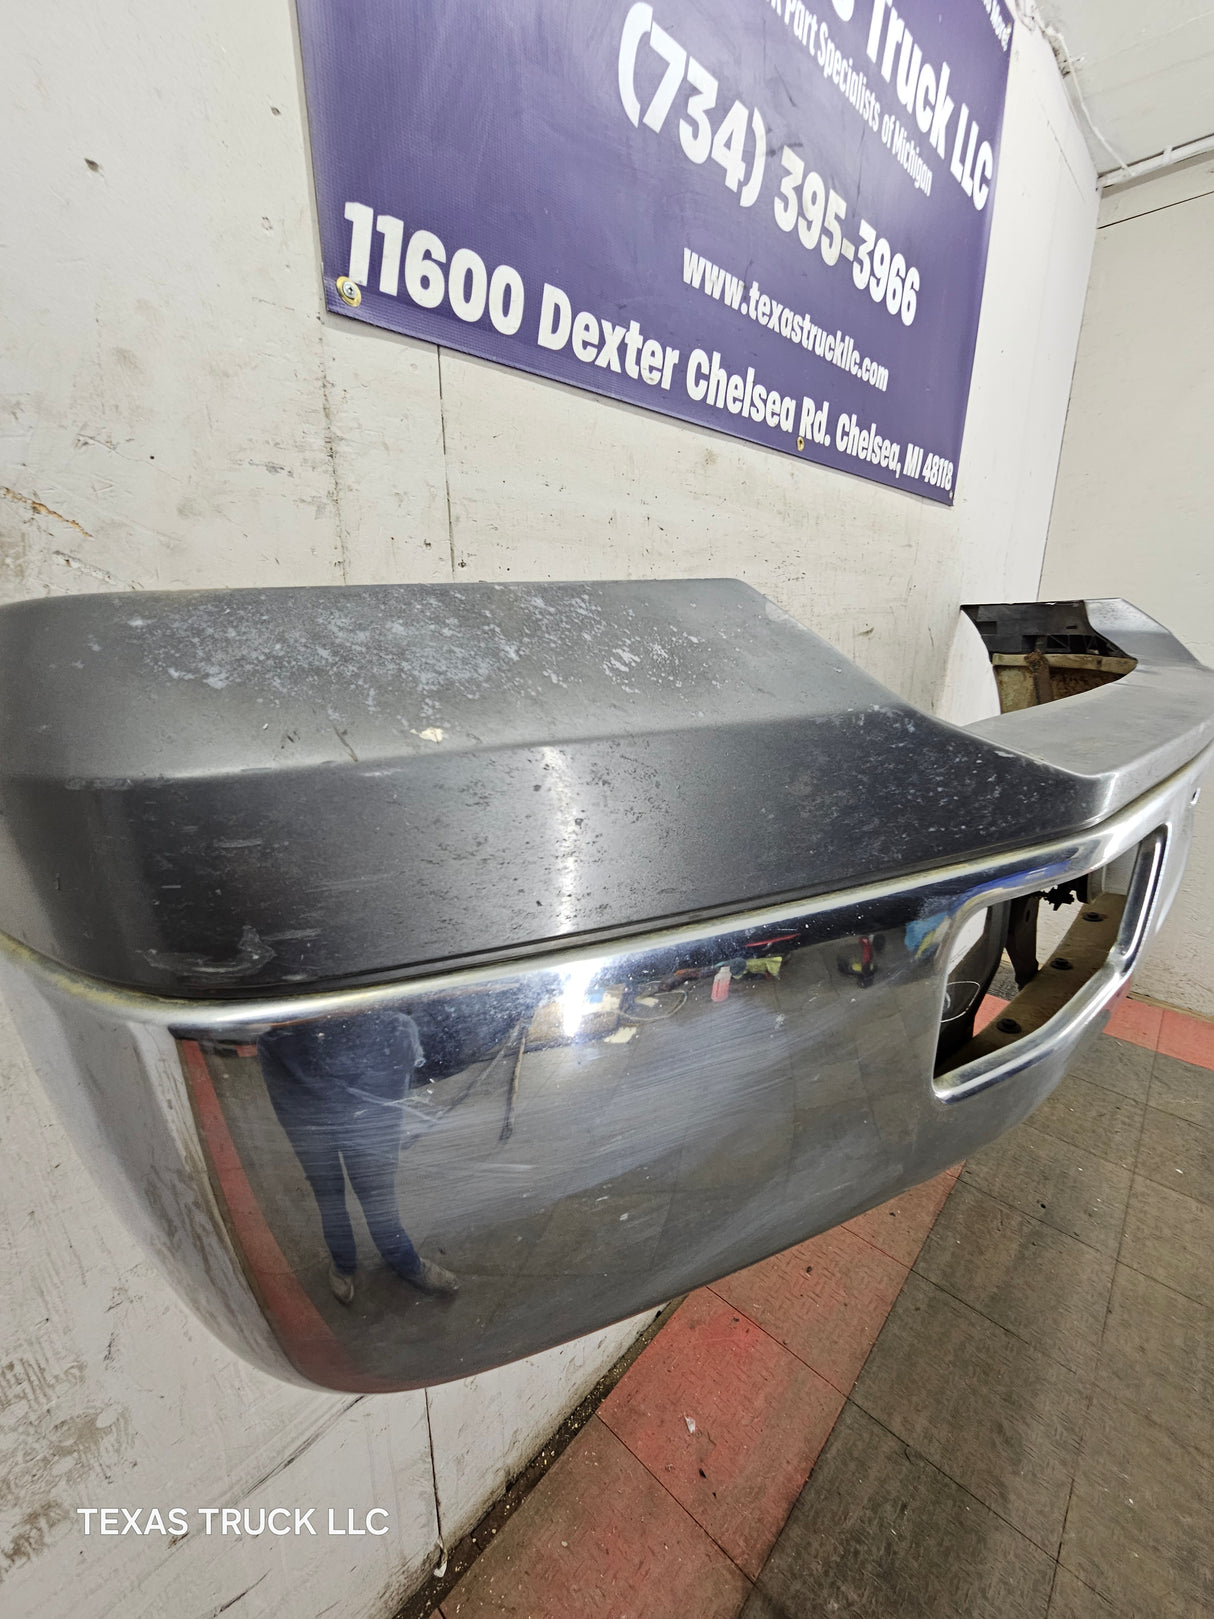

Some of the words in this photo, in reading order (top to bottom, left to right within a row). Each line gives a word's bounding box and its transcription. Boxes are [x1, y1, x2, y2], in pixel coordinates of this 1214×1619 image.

[618, 2, 767, 207] (734)
[773, 145, 920, 326] 395-3966
[816, 22, 881, 133] Specialists
[880, 114, 895, 149] of
[892, 120, 933, 197] Michigan
[950, 102, 993, 211] LLC
[344, 201, 525, 335] 11600
[537, 282, 679, 391] Dexter
[686, 348, 797, 433] Chelsea
[799, 396, 831, 447] Rd.
[835, 413, 901, 479] Chelsea,
[903, 442, 925, 479] MI
[921, 452, 953, 491] 48118
[682, 246, 889, 392] www.texastruckllc.com
